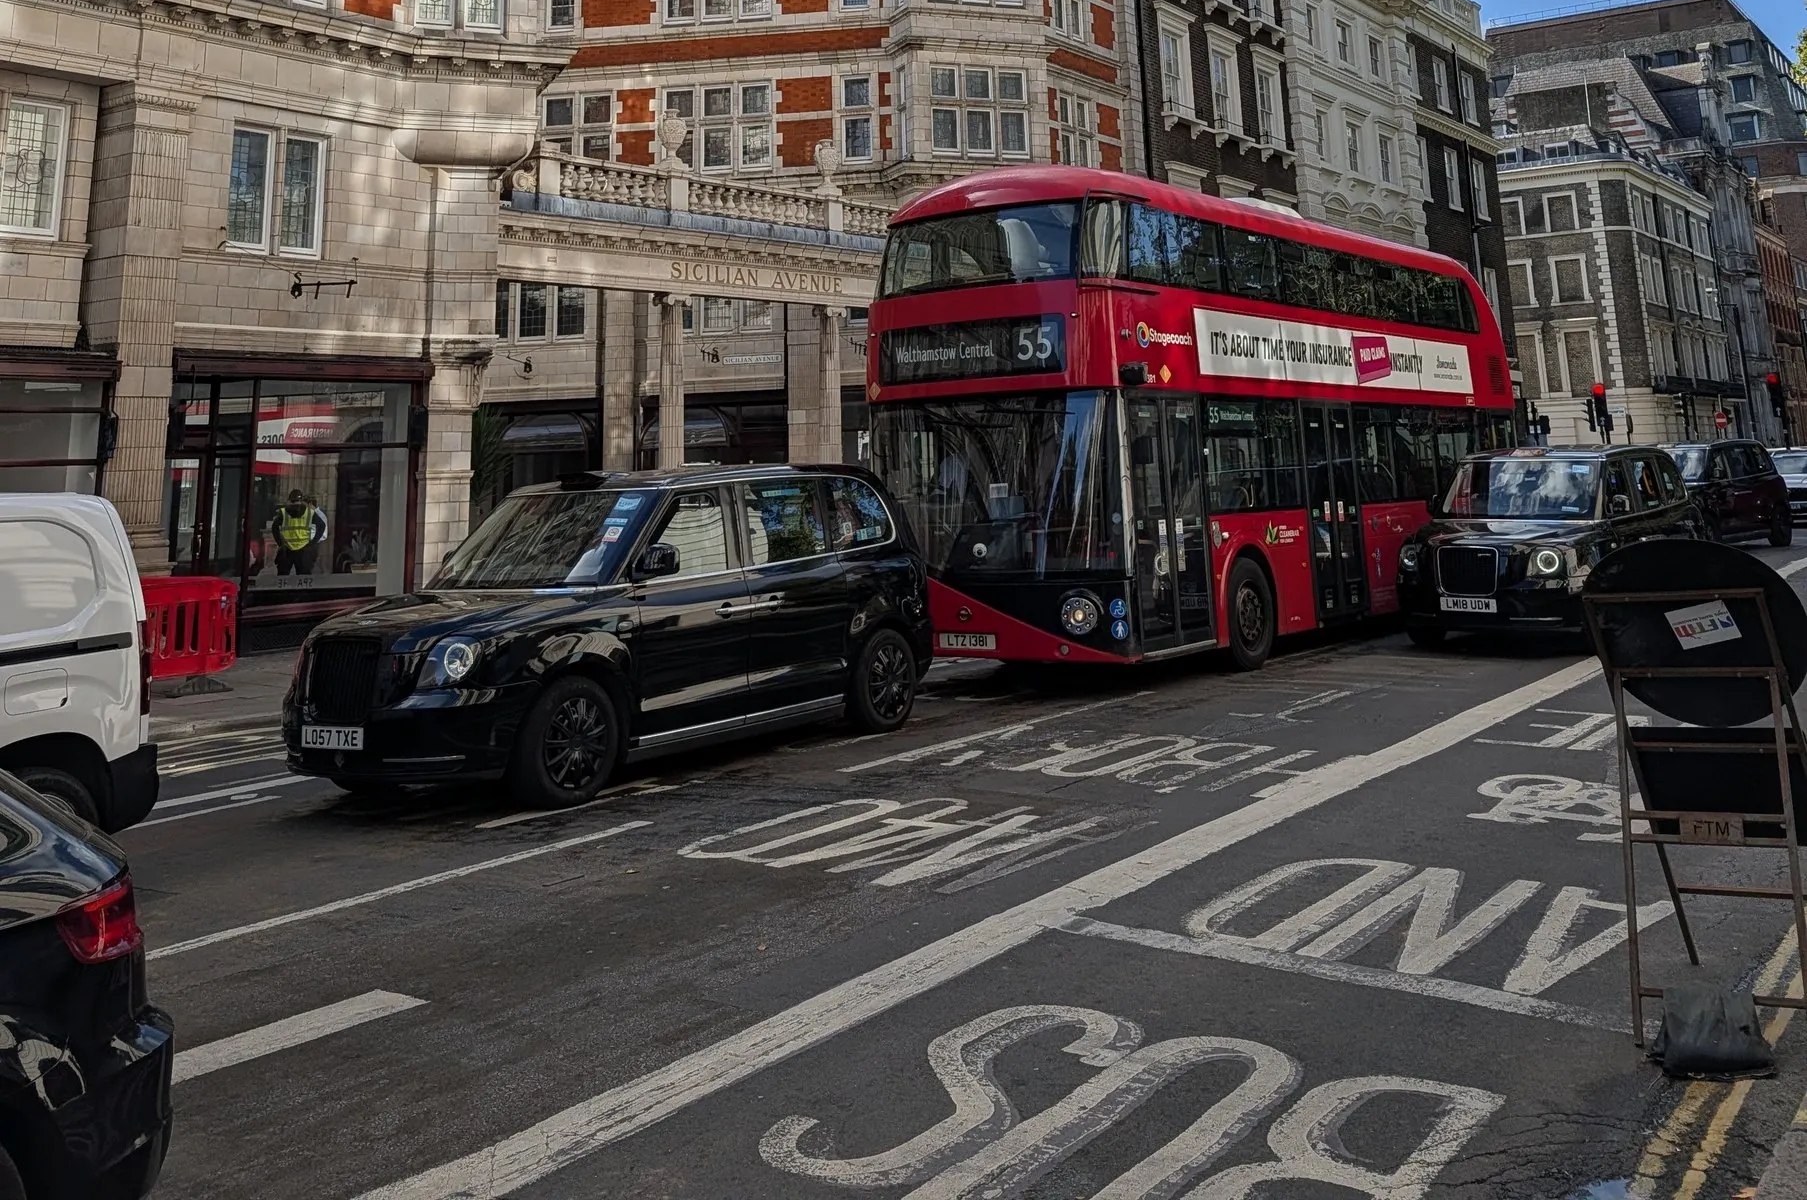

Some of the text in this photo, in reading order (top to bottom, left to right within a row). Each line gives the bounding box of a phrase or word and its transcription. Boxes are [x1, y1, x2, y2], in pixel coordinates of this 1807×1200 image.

[670, 261, 843, 294] SICILIAN AVENUE
[895, 326, 1052, 364] Walthamstow Central 55
[1150, 328, 1193, 347] Stagecoach
[1210, 330, 1228, 356] IT'S
[1230, 333, 1260, 359] ABOUT
[1262, 337, 1284, 361] TIME
[1284, 339, 1308, 364] YOUR
[1309, 342, 1352, 367] INSURANCE
[1389, 352, 1423, 374] INSTANTLY
[1209, 406, 1219, 423] 55
[1446, 598, 1490, 611] LM18 UDW
[947, 634, 988, 647] LTZ 1381
[304, 728, 358, 747] LO57 TXE
[1693, 820, 1731, 837] FTM
[1182, 858, 1675, 997] AND
